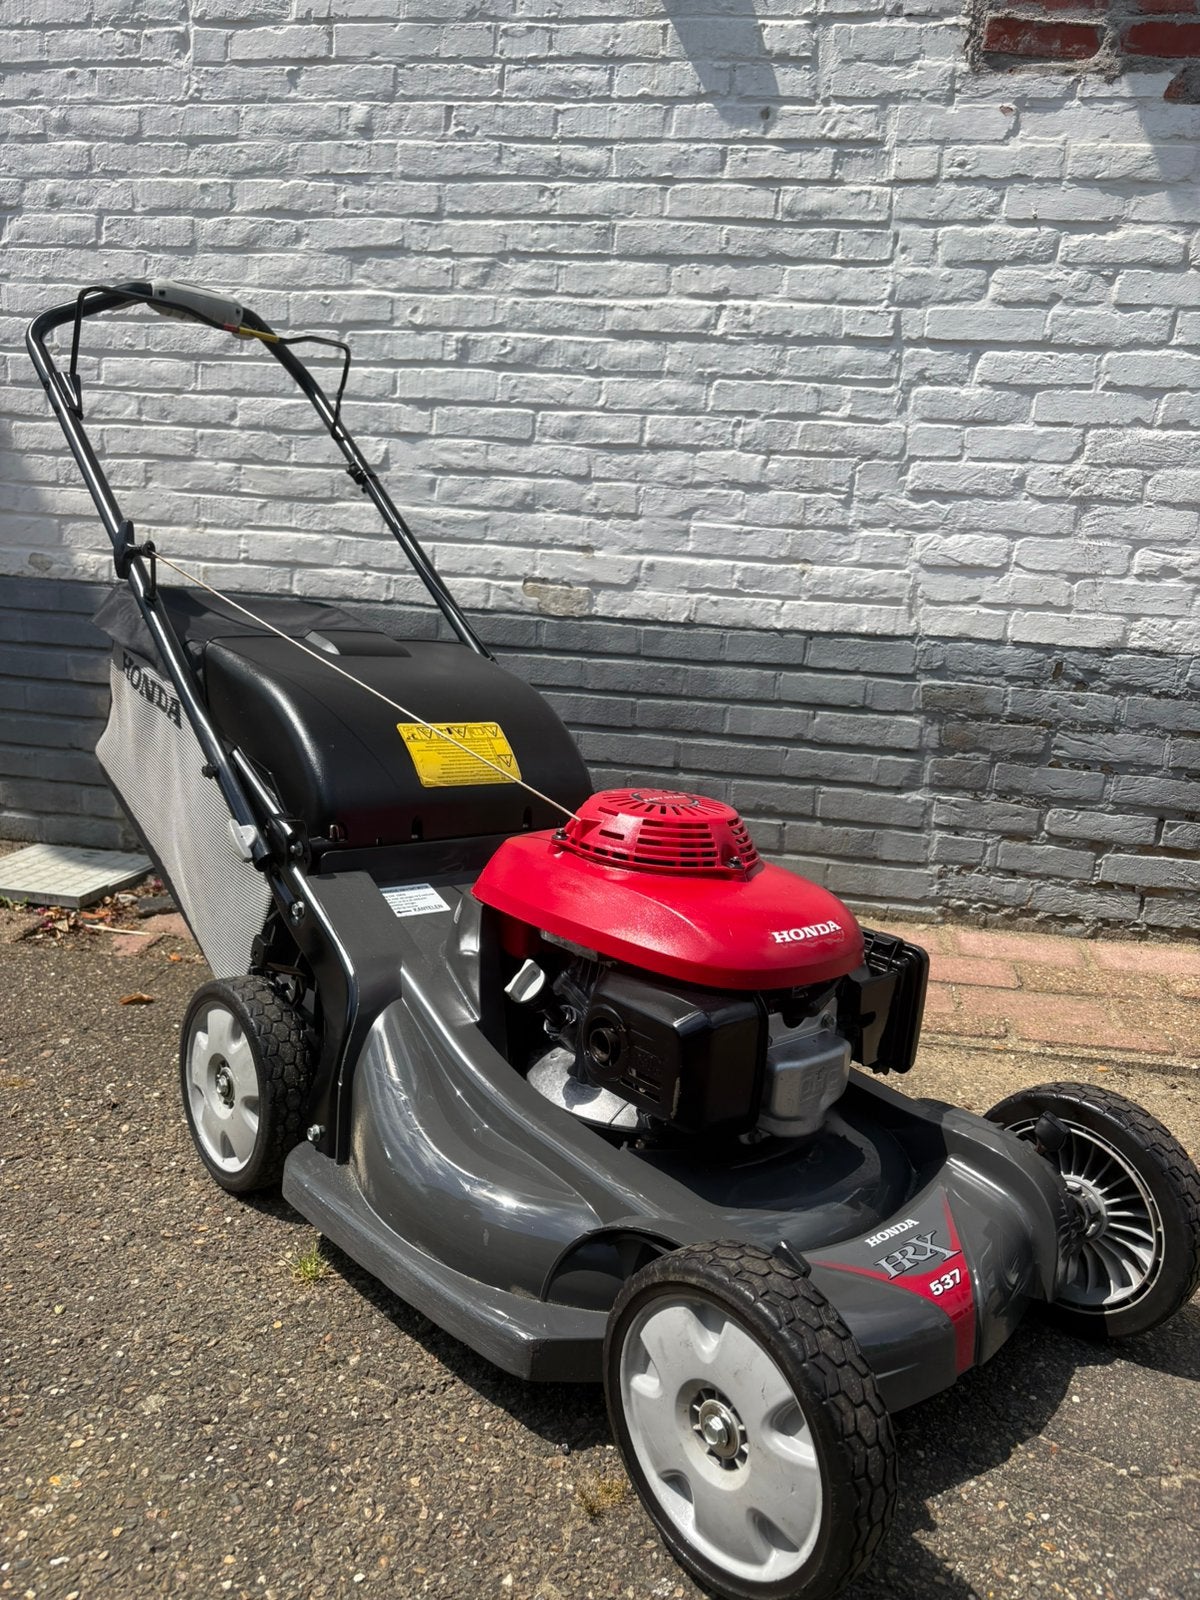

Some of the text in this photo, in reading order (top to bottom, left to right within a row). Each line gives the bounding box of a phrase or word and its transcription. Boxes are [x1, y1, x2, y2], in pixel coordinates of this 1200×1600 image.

[122, 648, 182, 730] HONDA
[771, 920, 841, 943] HONDA
[864, 1218, 920, 1248] HONDA
[873, 1230, 962, 1280] HRX
[929, 1268, 961, 1296] 537
